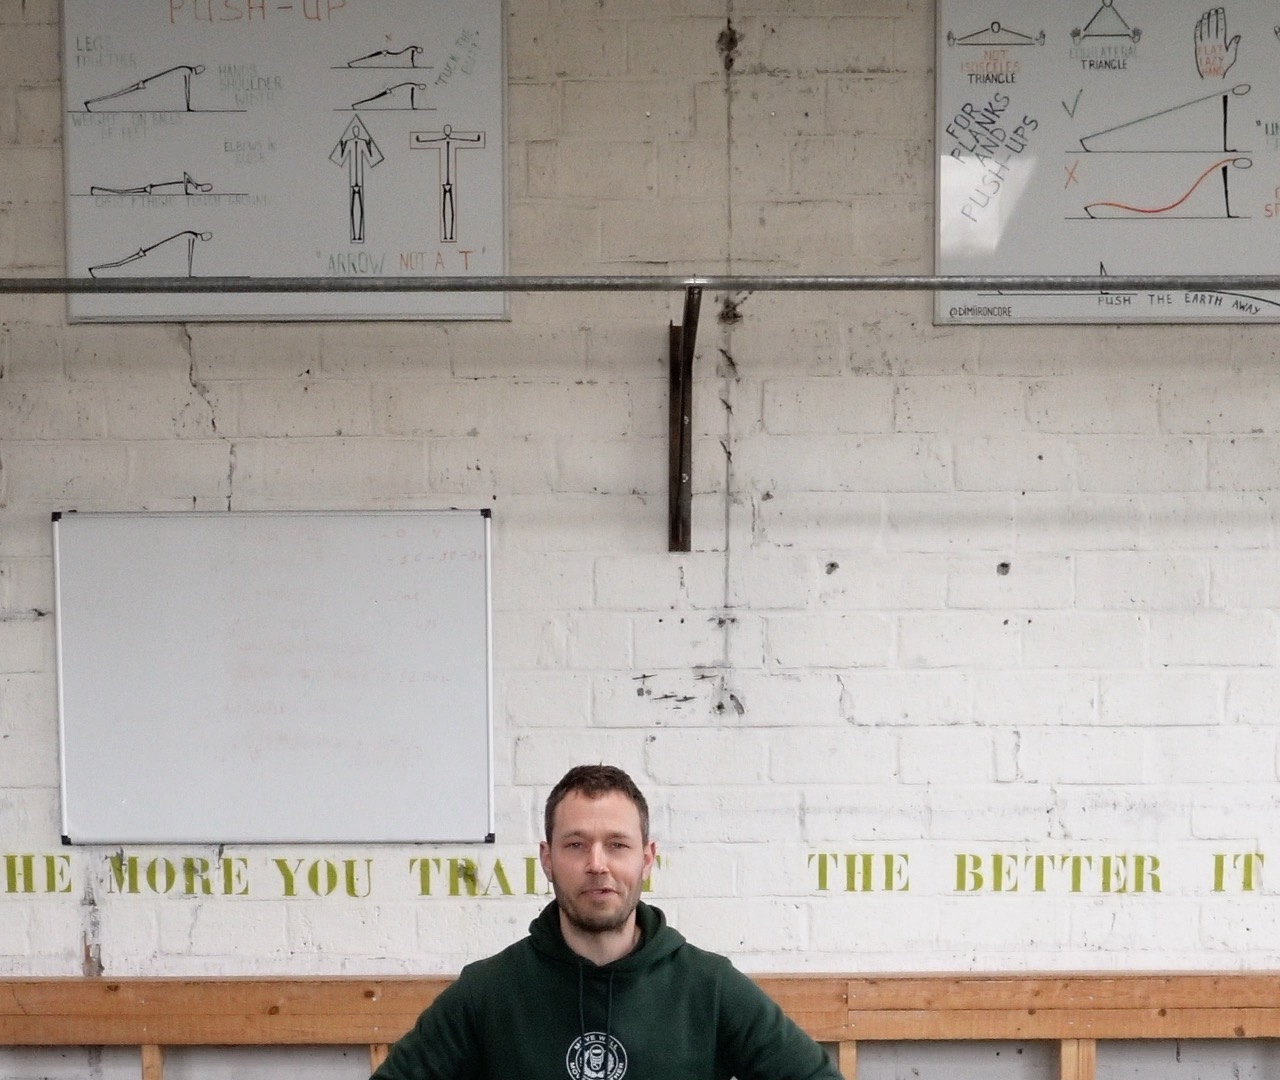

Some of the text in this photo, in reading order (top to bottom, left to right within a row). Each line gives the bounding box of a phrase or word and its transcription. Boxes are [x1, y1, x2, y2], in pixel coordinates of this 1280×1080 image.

[983, 49, 1009, 61] NOT
[1080, 59, 1128, 70] TRIANGLE
[967, 73, 1017, 85] TRIANGLE
[945, 102, 982, 140] FOR
[950, 92, 1011, 164] PLANKS
[975, 127, 1007, 168] AND
[960, 115, 1039, 223] PUSH-UPS
[400, 251, 427, 271] NOT
[435, 251, 446, 271] A
[1097, 293, 1262, 316] PUSH THE EARTH AWAY
[107, 854, 250, 895] MORE
[271, 857, 374, 898] YOU
[408, 856, 554, 897] TRAI
[807, 853, 910, 892] THE
[953, 853, 1163, 894] BETTER
[1211, 853, 1265, 892] IT
[573, 1034, 619, 1051] MVE WLL
